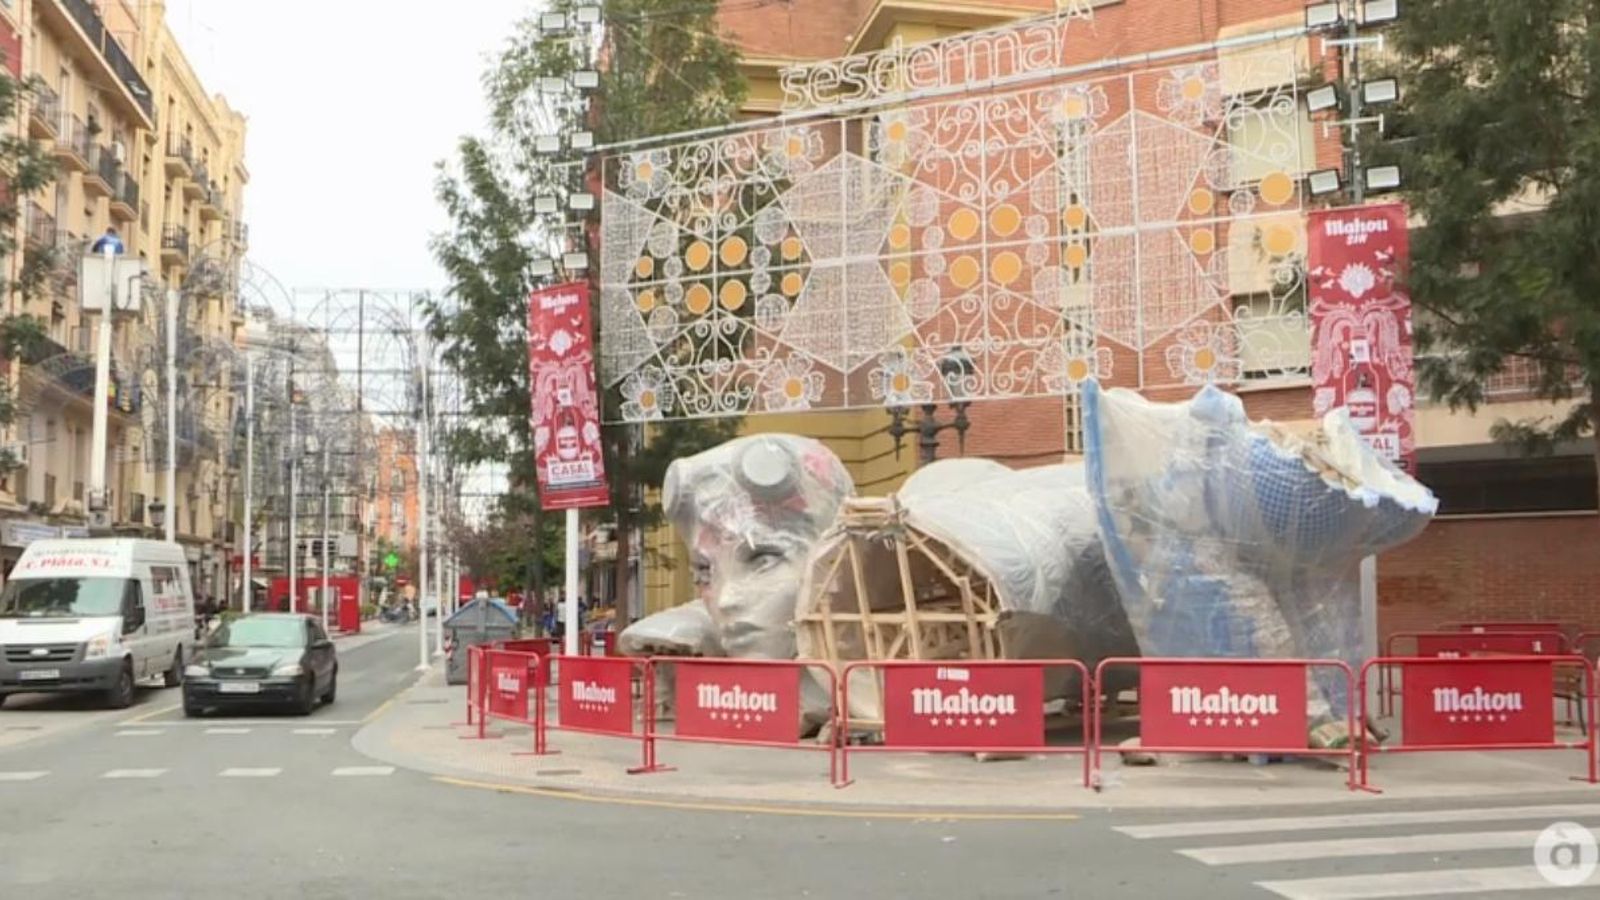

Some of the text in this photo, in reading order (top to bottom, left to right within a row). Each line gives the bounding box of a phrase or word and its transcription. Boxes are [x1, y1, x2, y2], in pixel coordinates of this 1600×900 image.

[780, 25, 1061, 110] sesderma
[1324, 216, 1388, 236] Mahou
[572, 680, 617, 704] Mahou
[696, 683, 778, 713] Mahou
[911, 687, 1017, 715] Mahou
[1169, 685, 1280, 715] Mahou
[1433, 685, 1523, 712] Mahou
